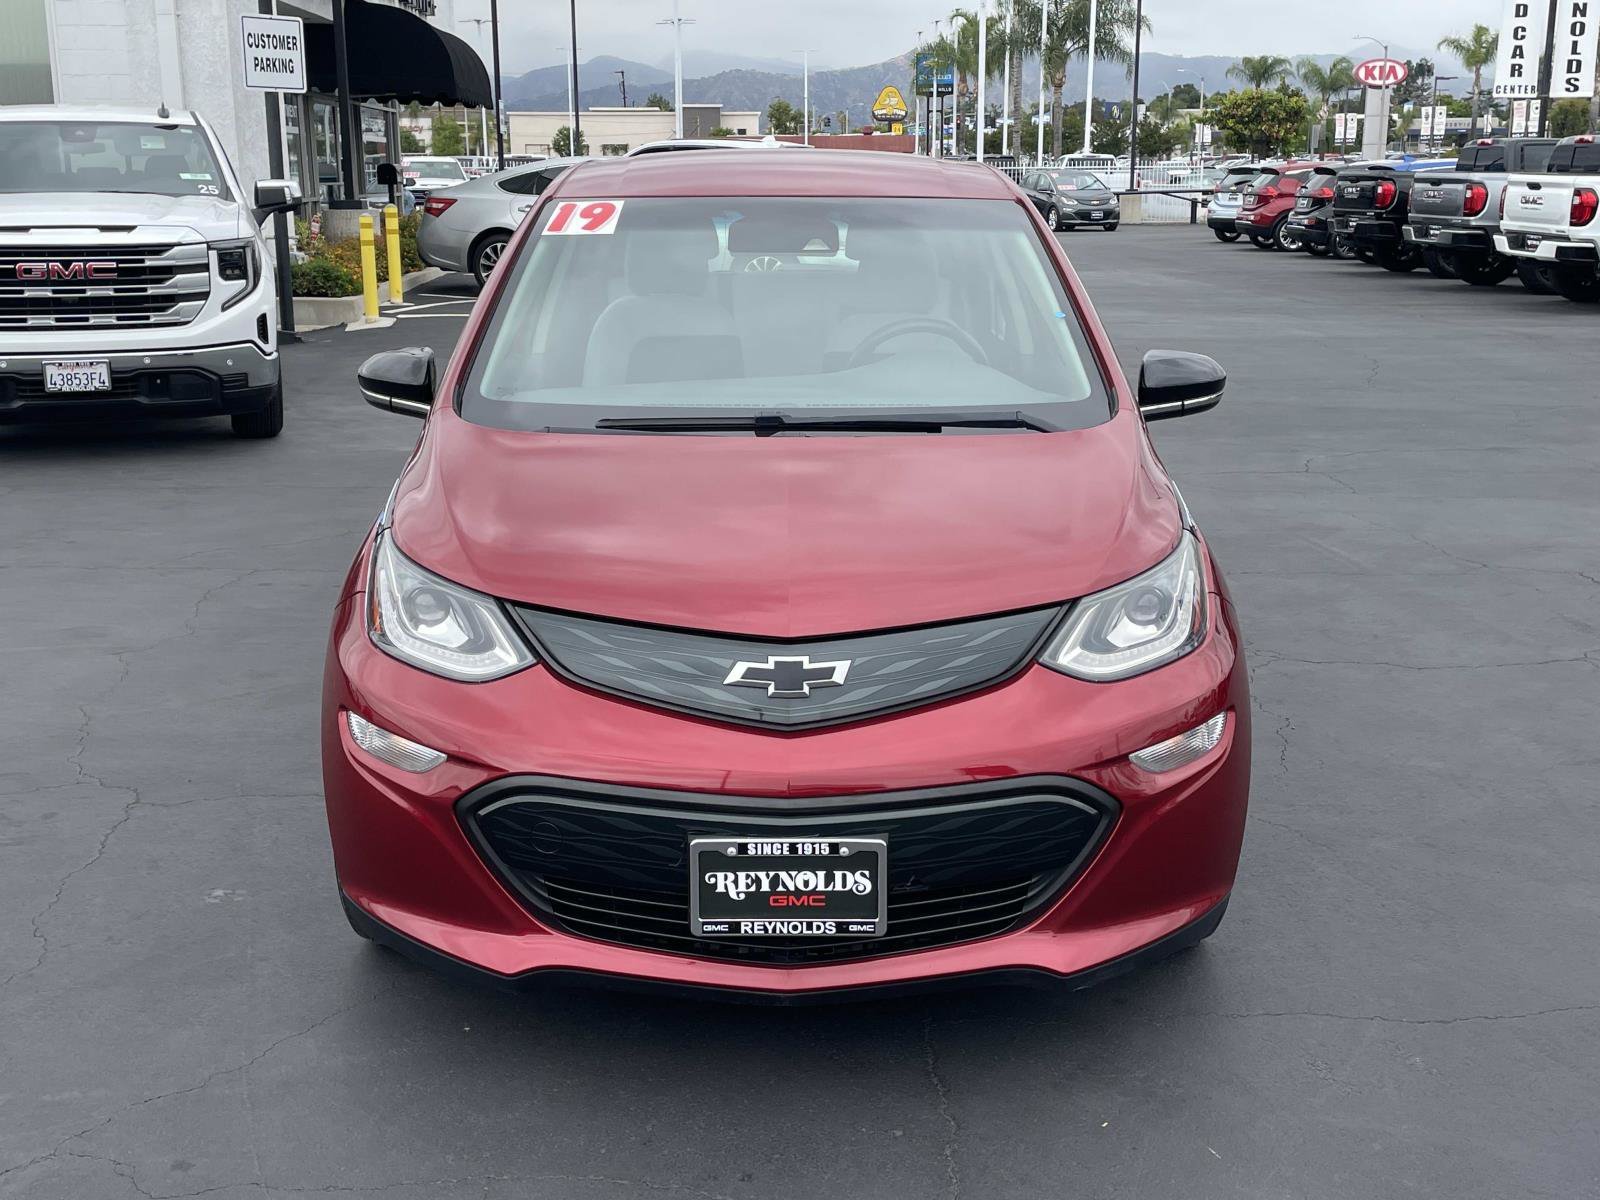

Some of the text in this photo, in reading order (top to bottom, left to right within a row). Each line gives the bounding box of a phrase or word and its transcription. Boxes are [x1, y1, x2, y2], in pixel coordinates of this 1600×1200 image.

[247, 32, 298, 51] CUSTOMER
[1565, 2, 1588, 93] NOLDS
[1509, 26, 1527, 78] CAR
[254, 56, 295, 74] PARKING
[1364, 65, 1399, 81] KIA
[1495, 85, 1537, 95] CENTER
[197, 184, 219, 195] 25
[547, 202, 617, 232] 19
[15, 262, 118, 280] GMC
[49, 372, 106, 386] 43853F4
[747, 843, 830, 855] SINCE 1915
[704, 870, 872, 900] REYNOLDS
[769, 895, 826, 907] GMC
[703, 922, 875, 934] GMC REYNOLDS GMC
